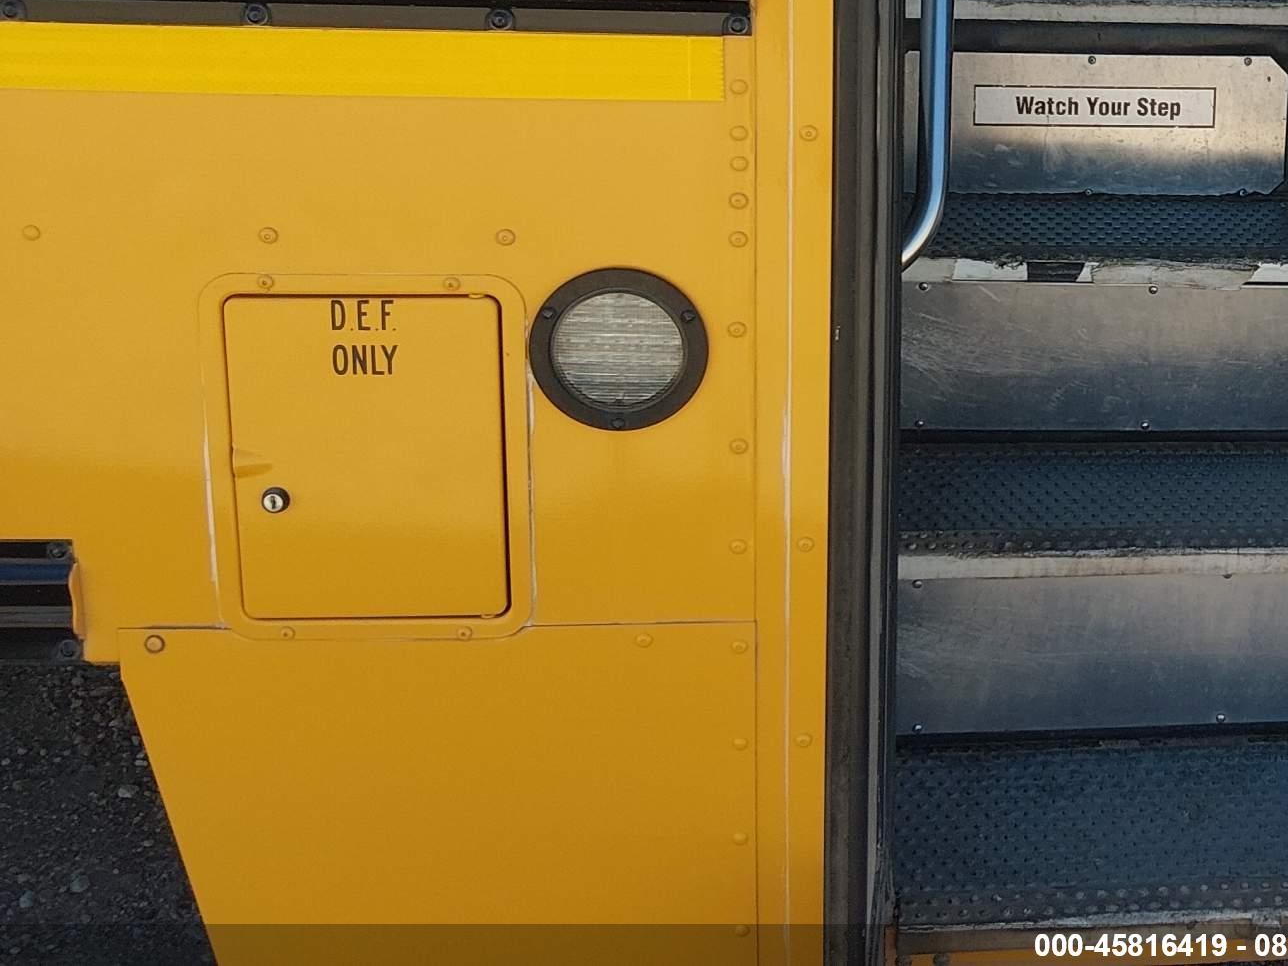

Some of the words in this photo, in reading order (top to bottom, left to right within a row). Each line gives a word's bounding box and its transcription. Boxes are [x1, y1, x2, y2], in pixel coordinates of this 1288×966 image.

[1016, 96, 1079, 116] Watch
[1086, 96, 1131, 116] Your
[1136, 97, 1181, 121] Step
[332, 344, 399, 376] ONLY
